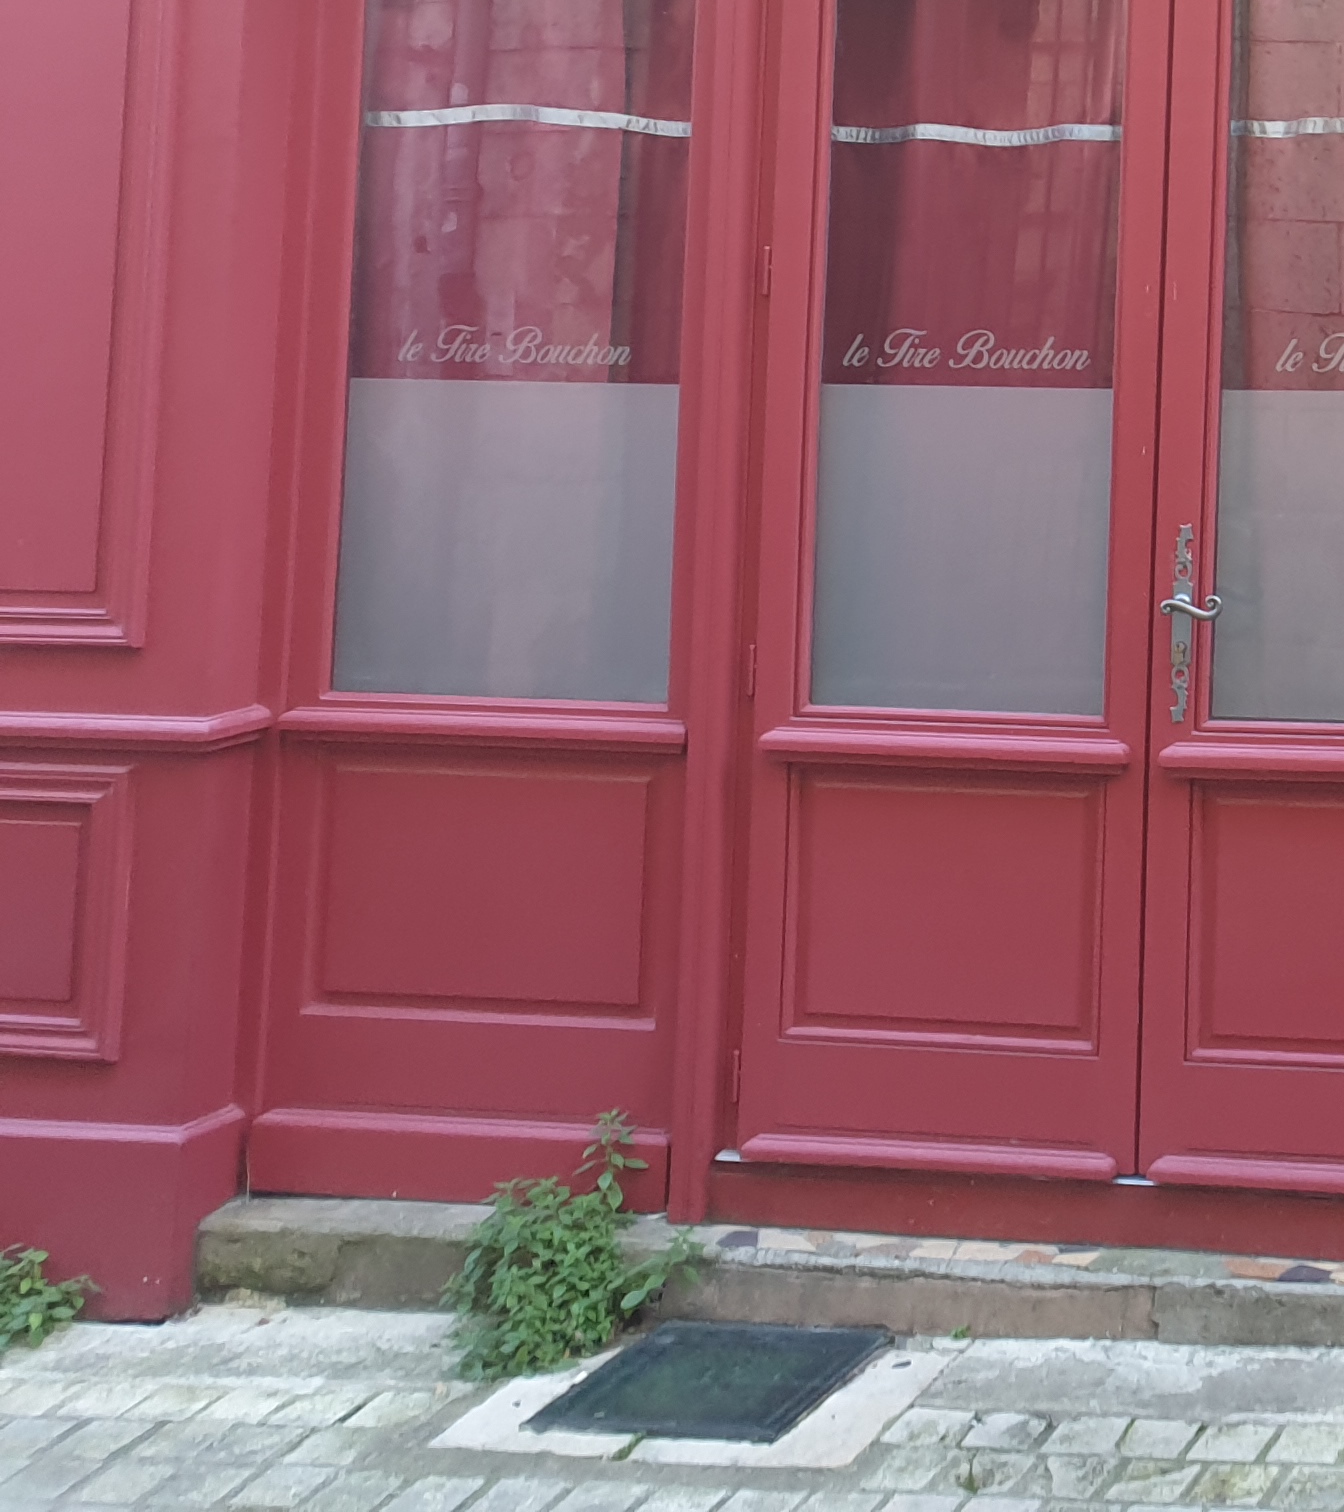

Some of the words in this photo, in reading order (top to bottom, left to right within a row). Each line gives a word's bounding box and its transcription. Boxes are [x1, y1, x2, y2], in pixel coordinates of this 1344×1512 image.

[398, 329, 424, 362] le
[431, 324, 491, 364] Tire
[499, 326, 632, 366] Bouchon
[843, 333, 870, 367] le
[876, 328, 941, 368] Tire
[949, 329, 1092, 370] Bouchon
[1275, 338, 1303, 373] le
